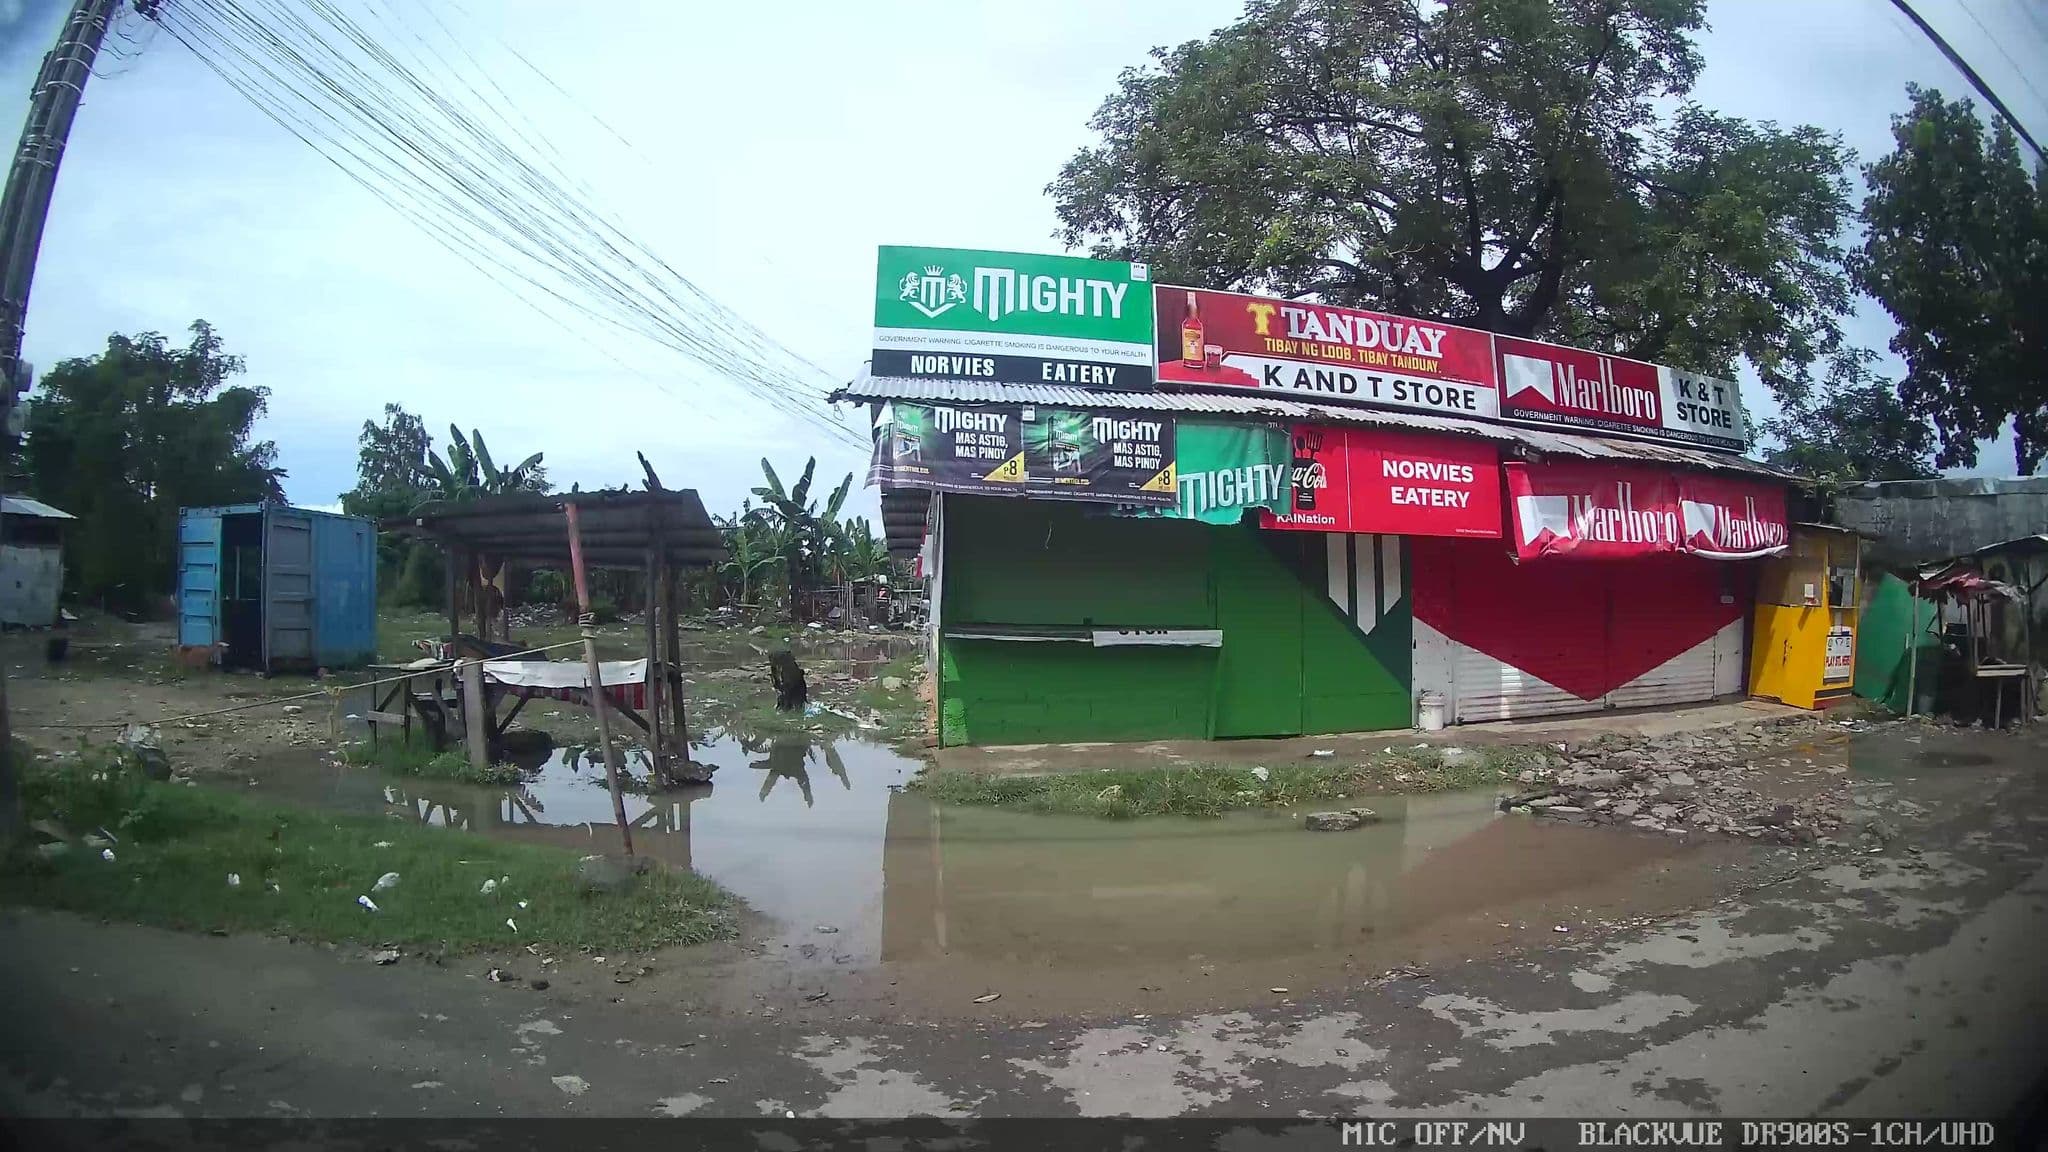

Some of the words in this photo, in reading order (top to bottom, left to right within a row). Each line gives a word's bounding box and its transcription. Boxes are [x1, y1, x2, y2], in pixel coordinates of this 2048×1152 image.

[973, 267, 1128, 321] MIGHTY
[1280, 306, 1446, 358] TANDUAY
[1264, 337, 1298, 355] TIBAY
[1302, 341, 1318, 357] NG
[1357, 349, 1388, 366] TIBAY
[911, 355, 995, 378] NORVIES
[1042, 362, 1117, 385] EATERY
[1264, 364, 1282, 388] K
[1293, 368, 1357, 394] AND
[1367, 376, 1383, 399] T
[1394, 380, 1477, 411] STORE
[1556, 357, 1656, 420] Marlboro
[1678, 378, 1692, 398] K
[1697, 382, 1711, 402] &
[1713, 386, 1725, 404] T
[935, 407, 1008, 433] MIGHTY
[1513, 408, 1562, 422] GOVERNMENT
[1632, 425, 1658, 436] SMOKING
[1677, 401, 1732, 429] STORE
[955, 432, 976, 444] MAS
[1092, 417, 1162, 443] MIGHTY
[955, 446, 976, 458] MAS
[978, 447, 1006, 460] PINOY
[1113, 442, 1134, 456] MAS
[1114, 455, 1134, 469] MAS
[1135, 456, 1161, 470] PINOY
[1382, 459, 1474, 483] NORVIES
[1177, 464, 1284, 519] MIGHTY
[1391, 486, 1470, 508] EATERY
[1572, 481, 1678, 543] Marlboro
